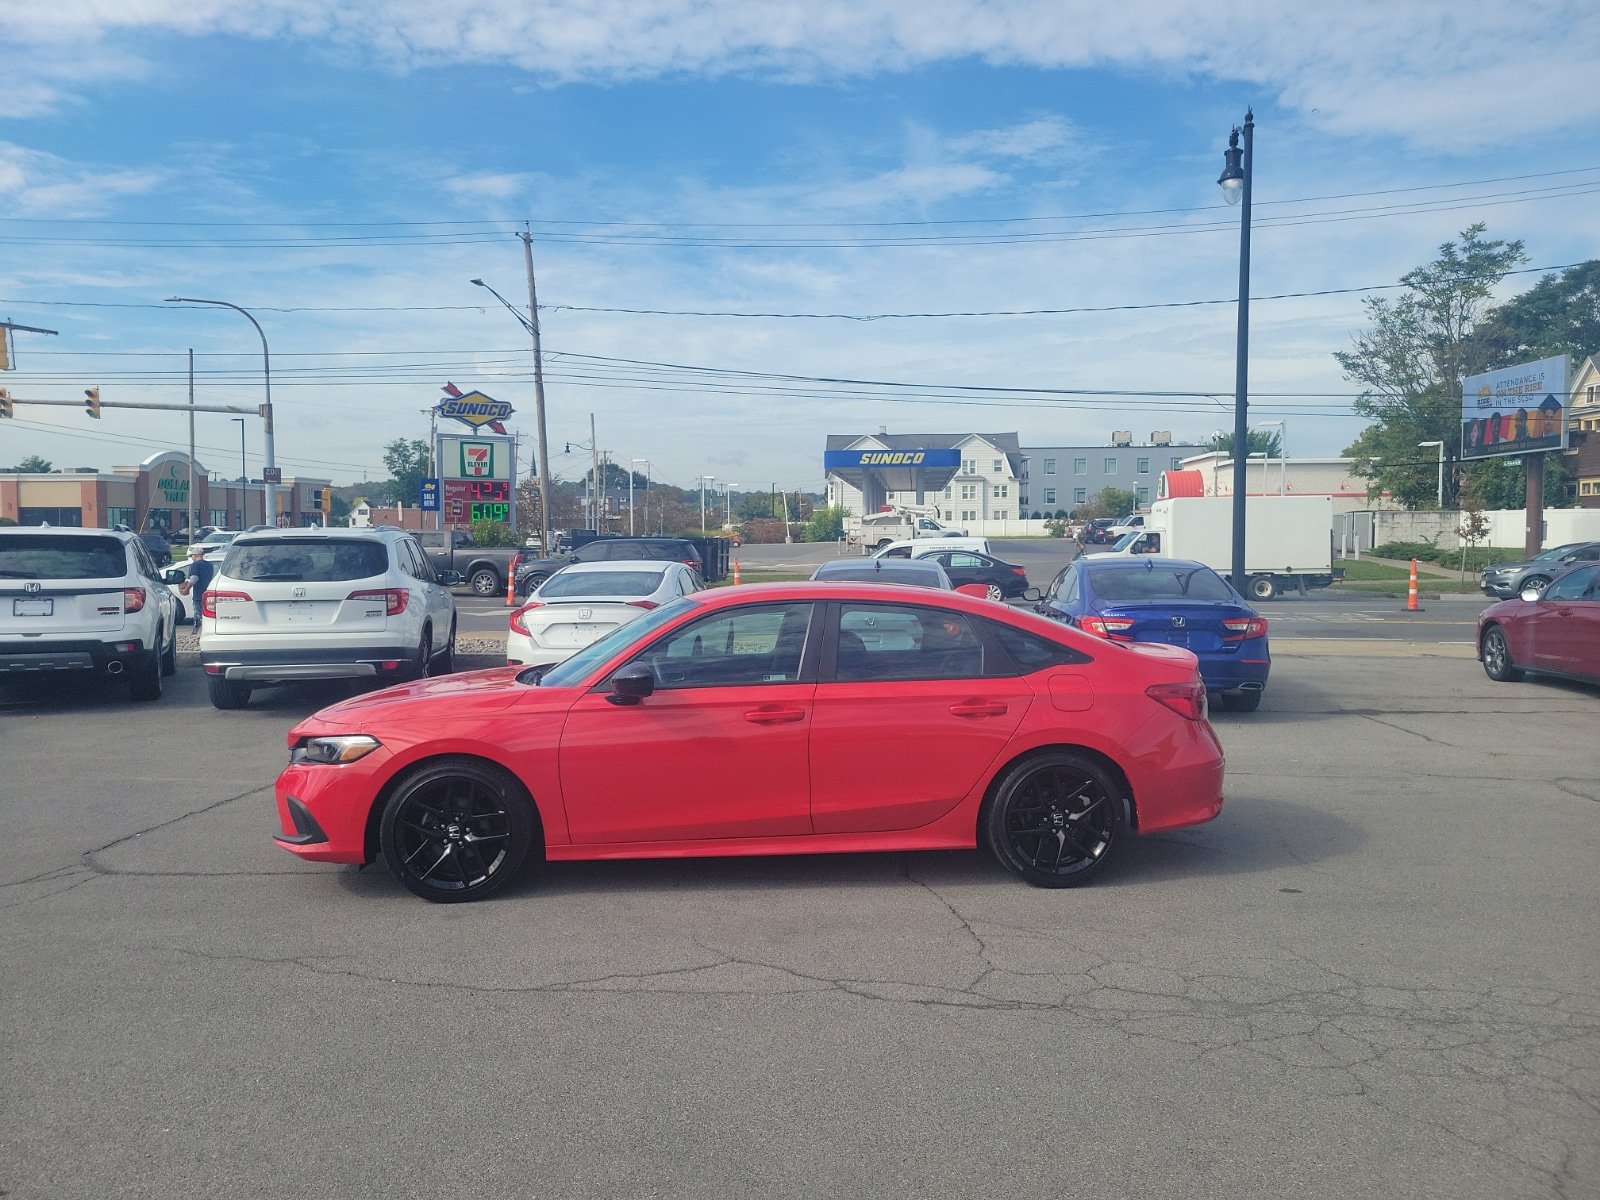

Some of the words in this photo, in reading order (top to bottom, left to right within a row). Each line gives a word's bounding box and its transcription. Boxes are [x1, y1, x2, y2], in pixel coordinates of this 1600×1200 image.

[1495, 374, 1536, 390] ATTENDANCE
[1538, 372, 1545, 381] IS
[1507, 385, 1523, 395] THE
[1524, 381, 1543, 393] RISE
[1495, 399, 1502, 407] IN
[1504, 396, 1516, 405] THE
[446, 401, 509, 416] SUNOCO
[467, 448, 488, 476] 7
[859, 452, 925, 465] SUNOCO
[157, 479, 190, 490] DOLLA
[445, 484, 467, 492] Regular
